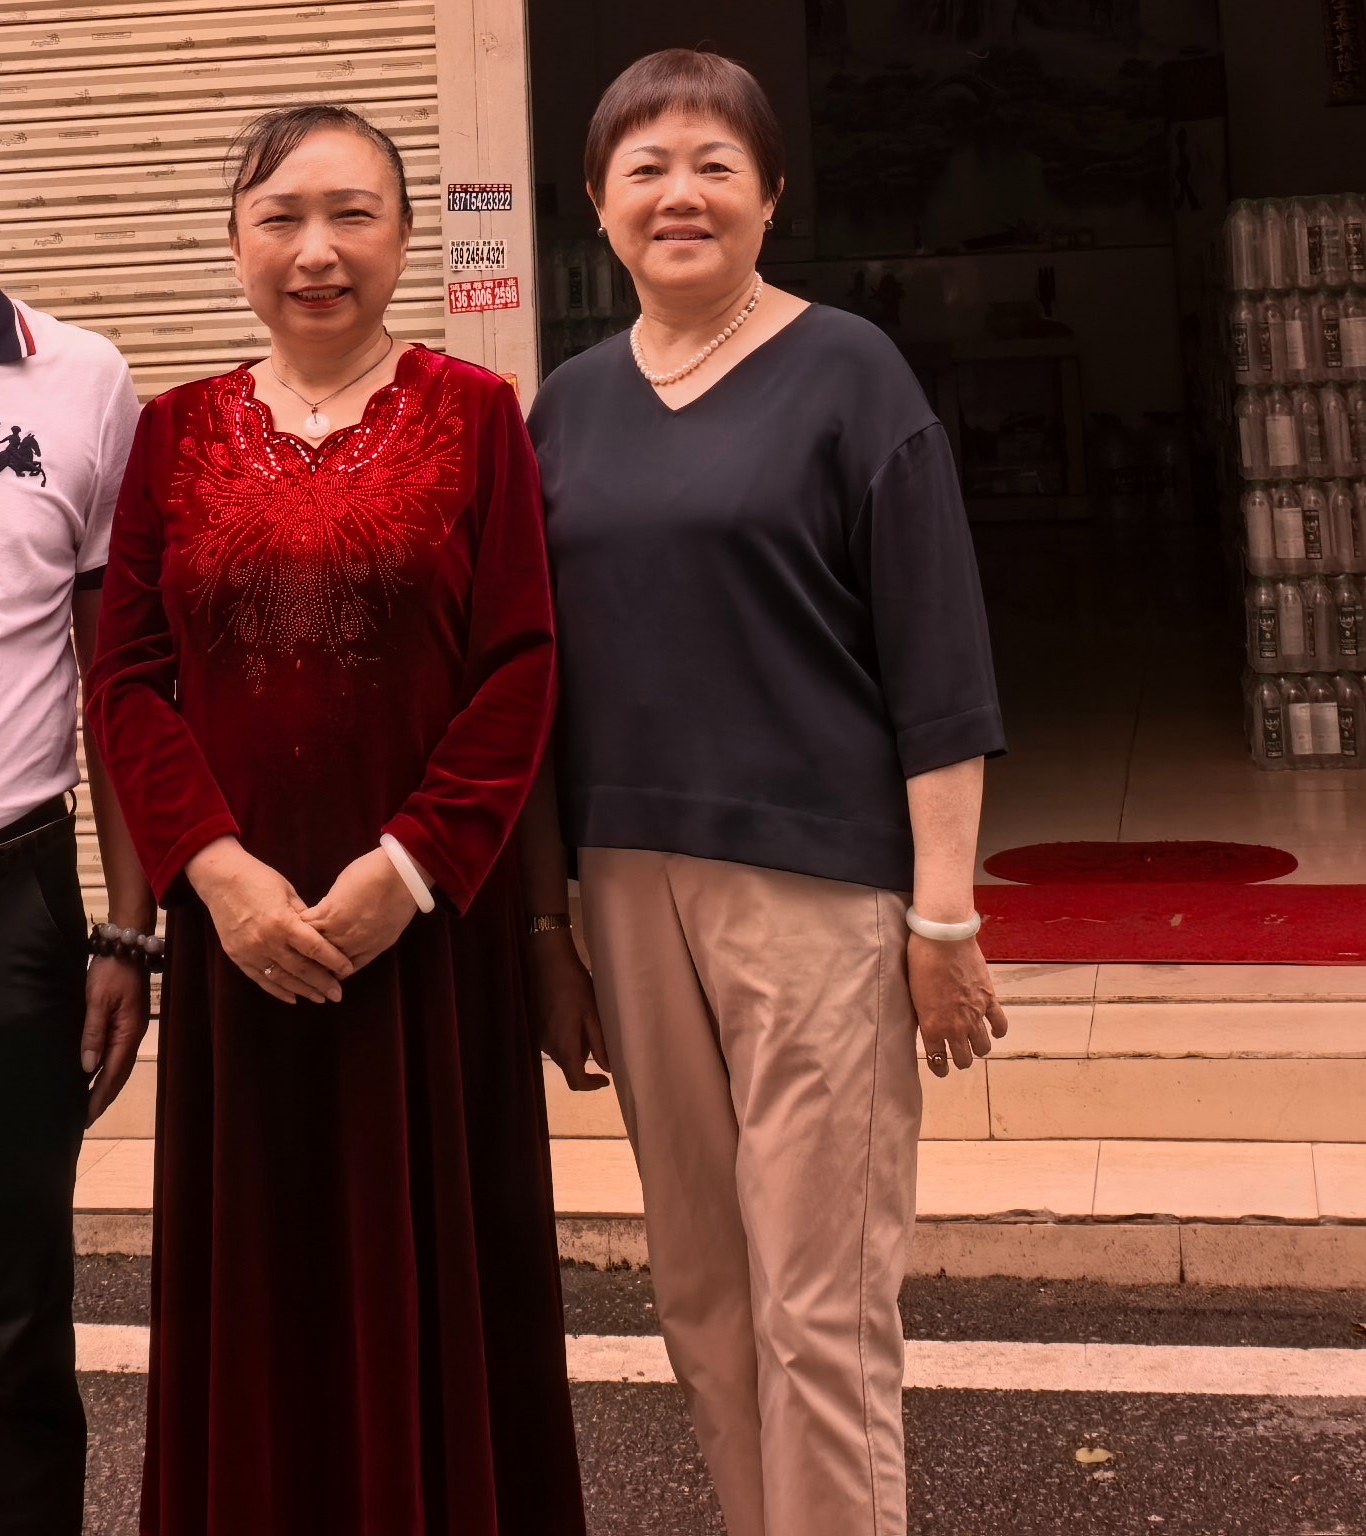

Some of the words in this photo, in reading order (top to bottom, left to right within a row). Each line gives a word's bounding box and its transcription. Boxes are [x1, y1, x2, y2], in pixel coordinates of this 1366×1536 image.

[449, 191, 511, 211] 13715423322
[451, 247, 464, 265] 139
[466, 246, 484, 265] 2454
[486, 246, 505, 265] 4321
[451, 290, 468, 309] 136
[470, 288, 493, 307] 3006
[494, 286, 518, 305] 2598
